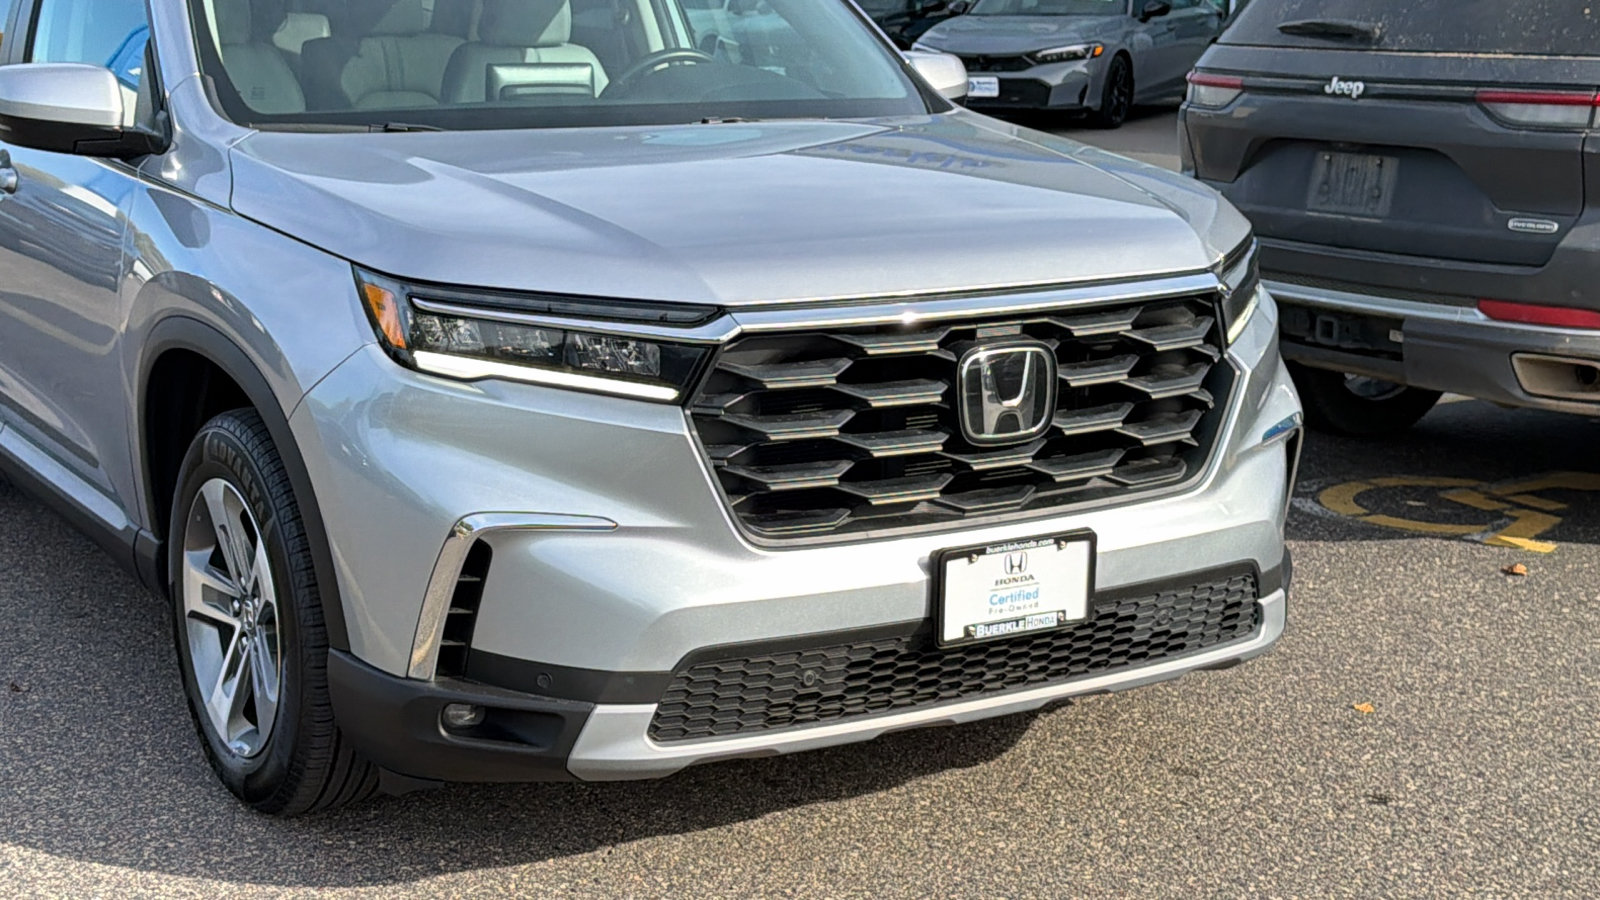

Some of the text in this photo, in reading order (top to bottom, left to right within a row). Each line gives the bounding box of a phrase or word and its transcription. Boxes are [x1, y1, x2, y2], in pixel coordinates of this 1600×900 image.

[1324, 76, 1364, 99] Jeep
[995, 574, 1035, 586] HONDA
[989, 587, 1039, 606] Certified
[975, 616, 1055, 638] BUERKLE HONDA
